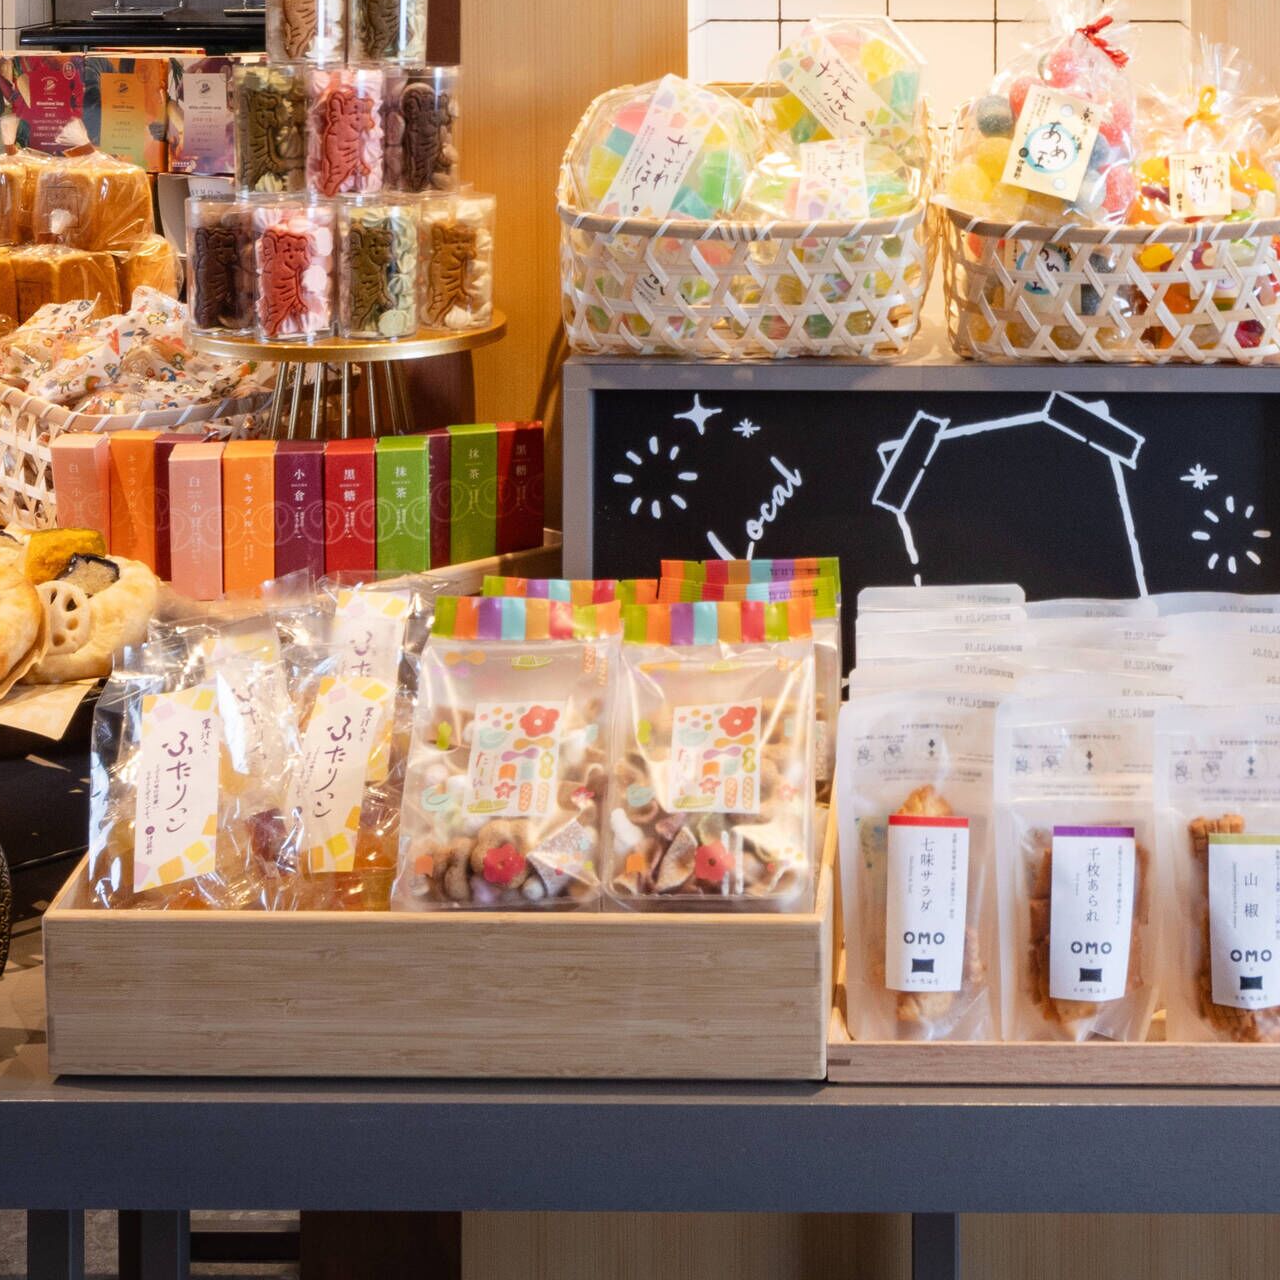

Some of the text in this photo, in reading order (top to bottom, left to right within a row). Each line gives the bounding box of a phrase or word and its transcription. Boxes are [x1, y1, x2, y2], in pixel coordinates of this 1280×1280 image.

[920, 836, 936, 913] 七味サラダ
[1086, 847, 1101, 923] 千枚あられ
[1244, 872, 1260, 918] 山椒
[903, 931, 945, 945] OMO
[1070, 940, 1112, 955] OMO
[1230, 949, 1272, 963] OMO
